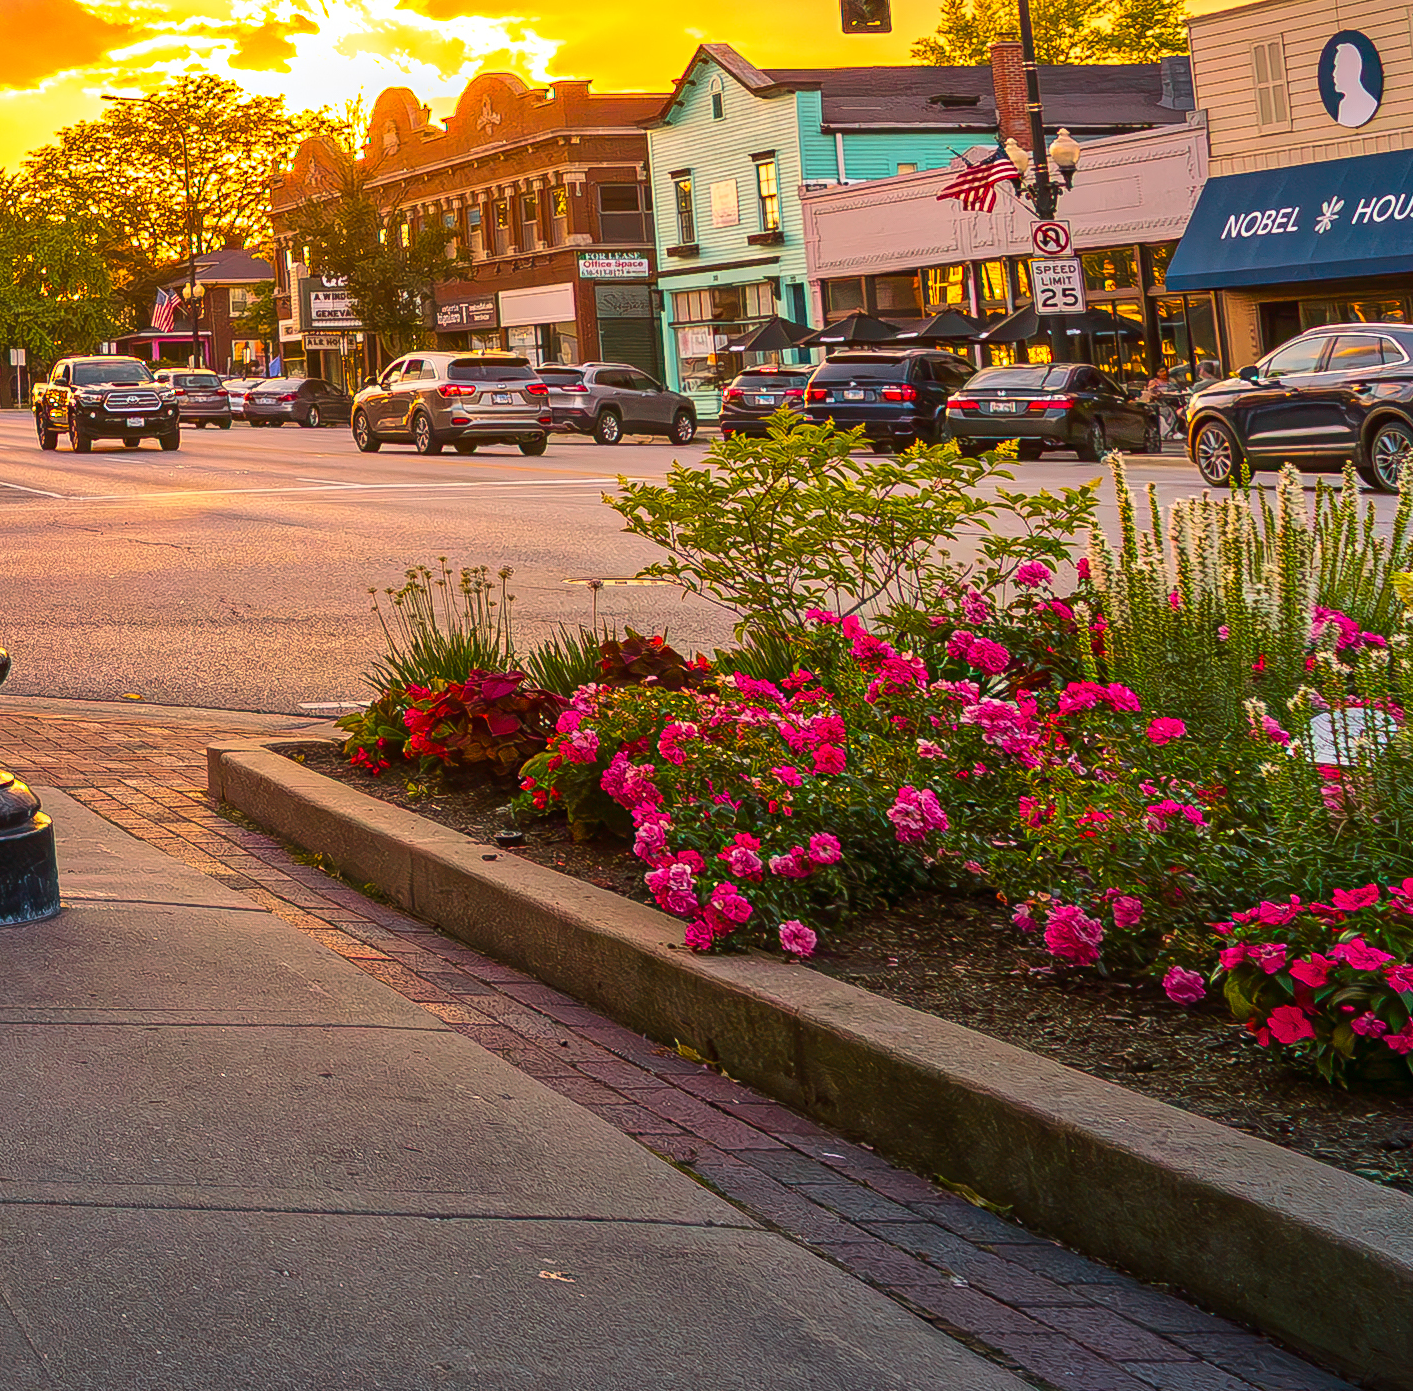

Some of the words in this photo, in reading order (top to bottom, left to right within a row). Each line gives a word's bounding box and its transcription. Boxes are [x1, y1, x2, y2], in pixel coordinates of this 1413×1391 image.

[1220, 206, 1300, 240] NOBEL
[1351, 193, 1413, 225] HOU
[585, 252, 607, 260] FOR
[608, 251, 641, 260] LEASE
[583, 260, 612, 268] Office
[614, 260, 644, 269] Space
[1035, 264, 1077, 275] SPEED
[1040, 276, 1073, 286] LIMIT
[1040, 287, 1079, 308] 25
[315, 309, 353, 318] GENEVA
